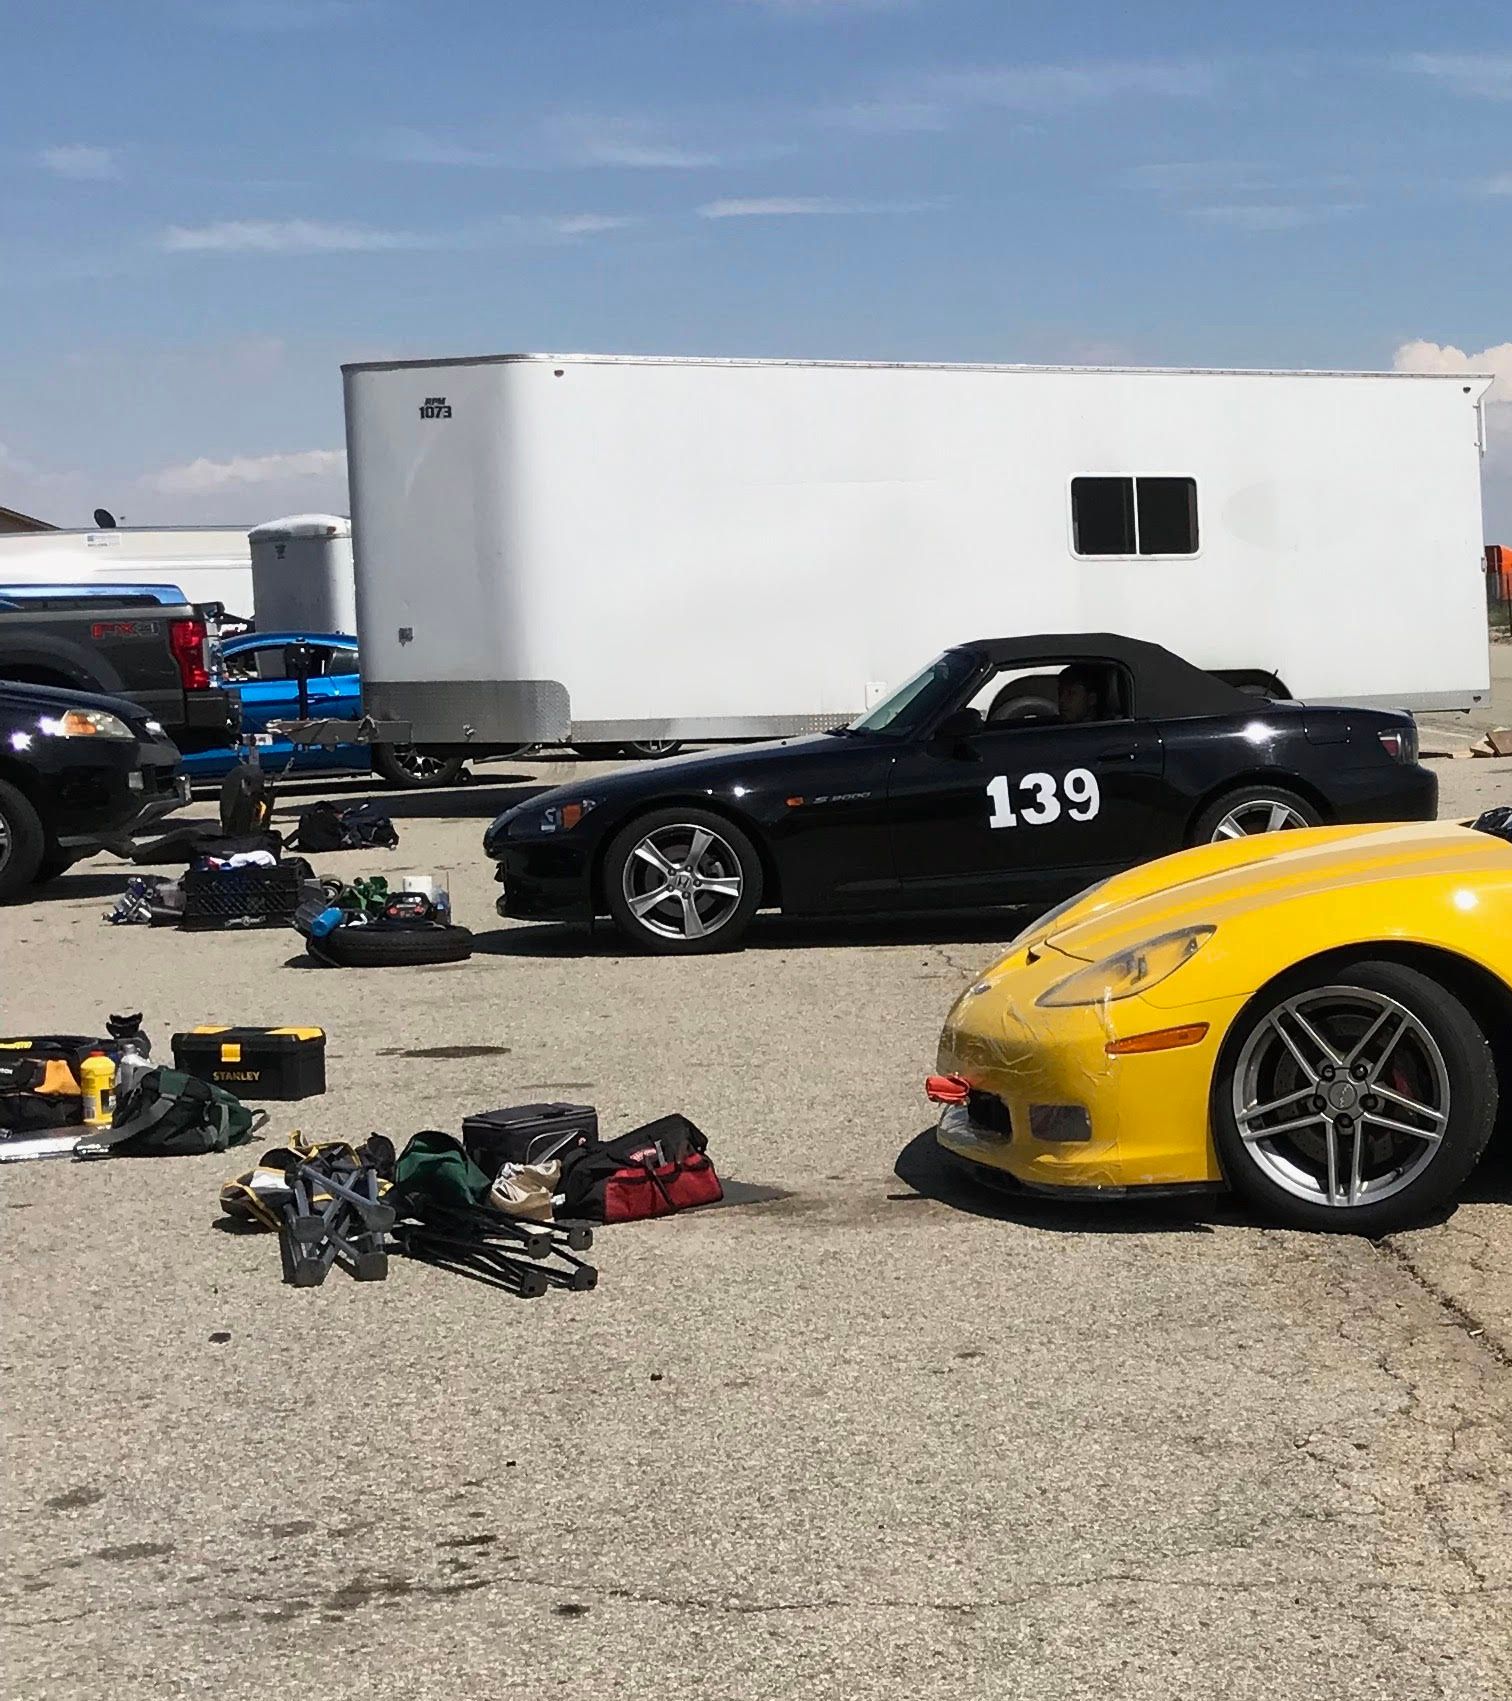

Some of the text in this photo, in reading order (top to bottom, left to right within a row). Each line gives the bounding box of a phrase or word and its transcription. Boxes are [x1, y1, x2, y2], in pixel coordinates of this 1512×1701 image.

[419, 405, 452, 419] 1073
[986, 768, 1100, 829] 139
[212, 1071, 260, 1081] STANLEY
